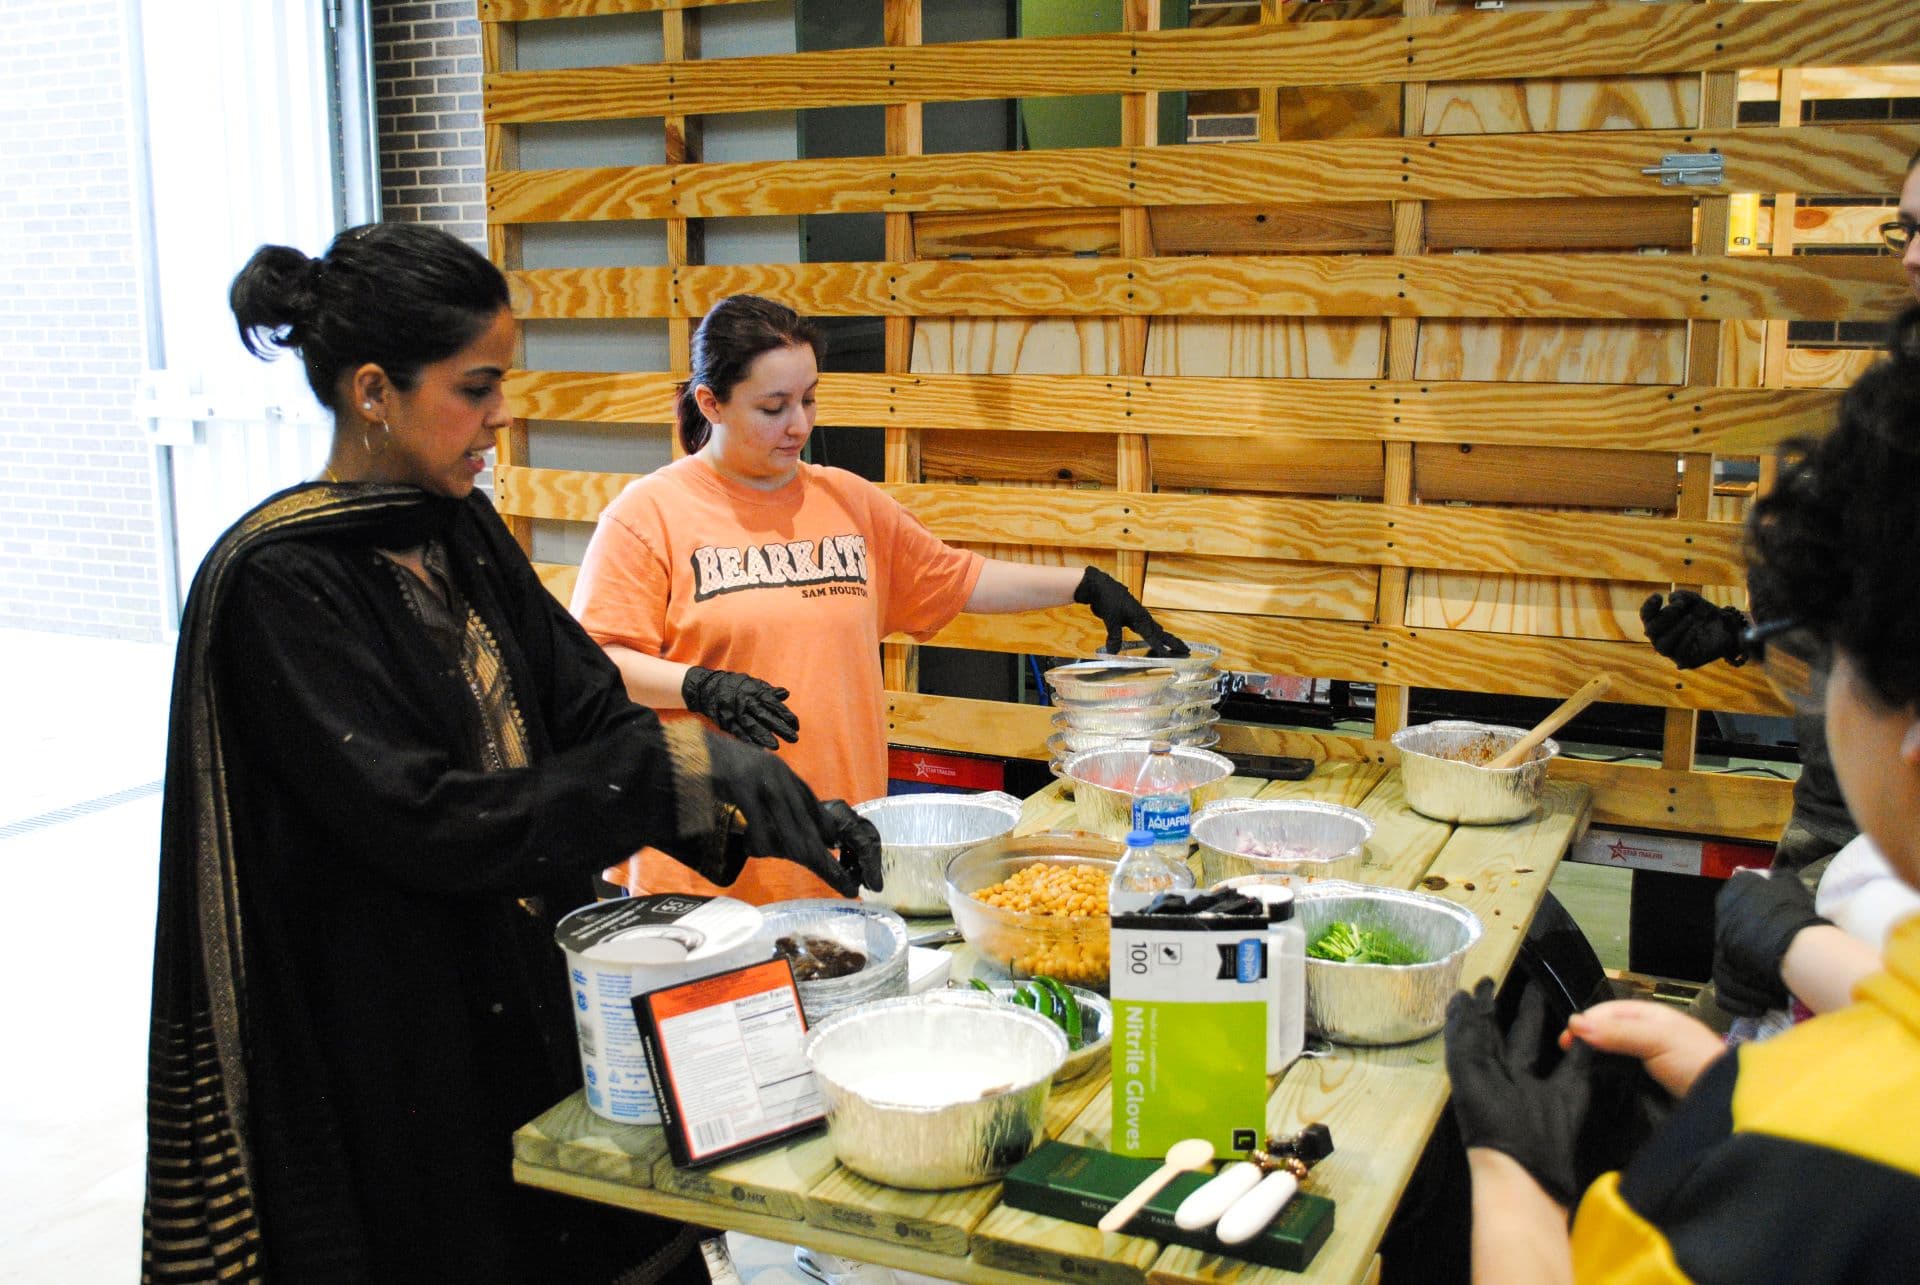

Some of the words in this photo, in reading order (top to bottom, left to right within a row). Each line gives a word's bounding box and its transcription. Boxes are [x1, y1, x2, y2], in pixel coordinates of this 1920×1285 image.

[801, 587, 826, 599] SAM
[1147, 814, 1190, 831] AQUAFIN
[1131, 941, 1148, 975] 100
[1125, 1006, 1145, 1074] Nitrile
[1125, 1079, 1145, 1151] Gloves
[1238, 1135, 1251, 1146] L
